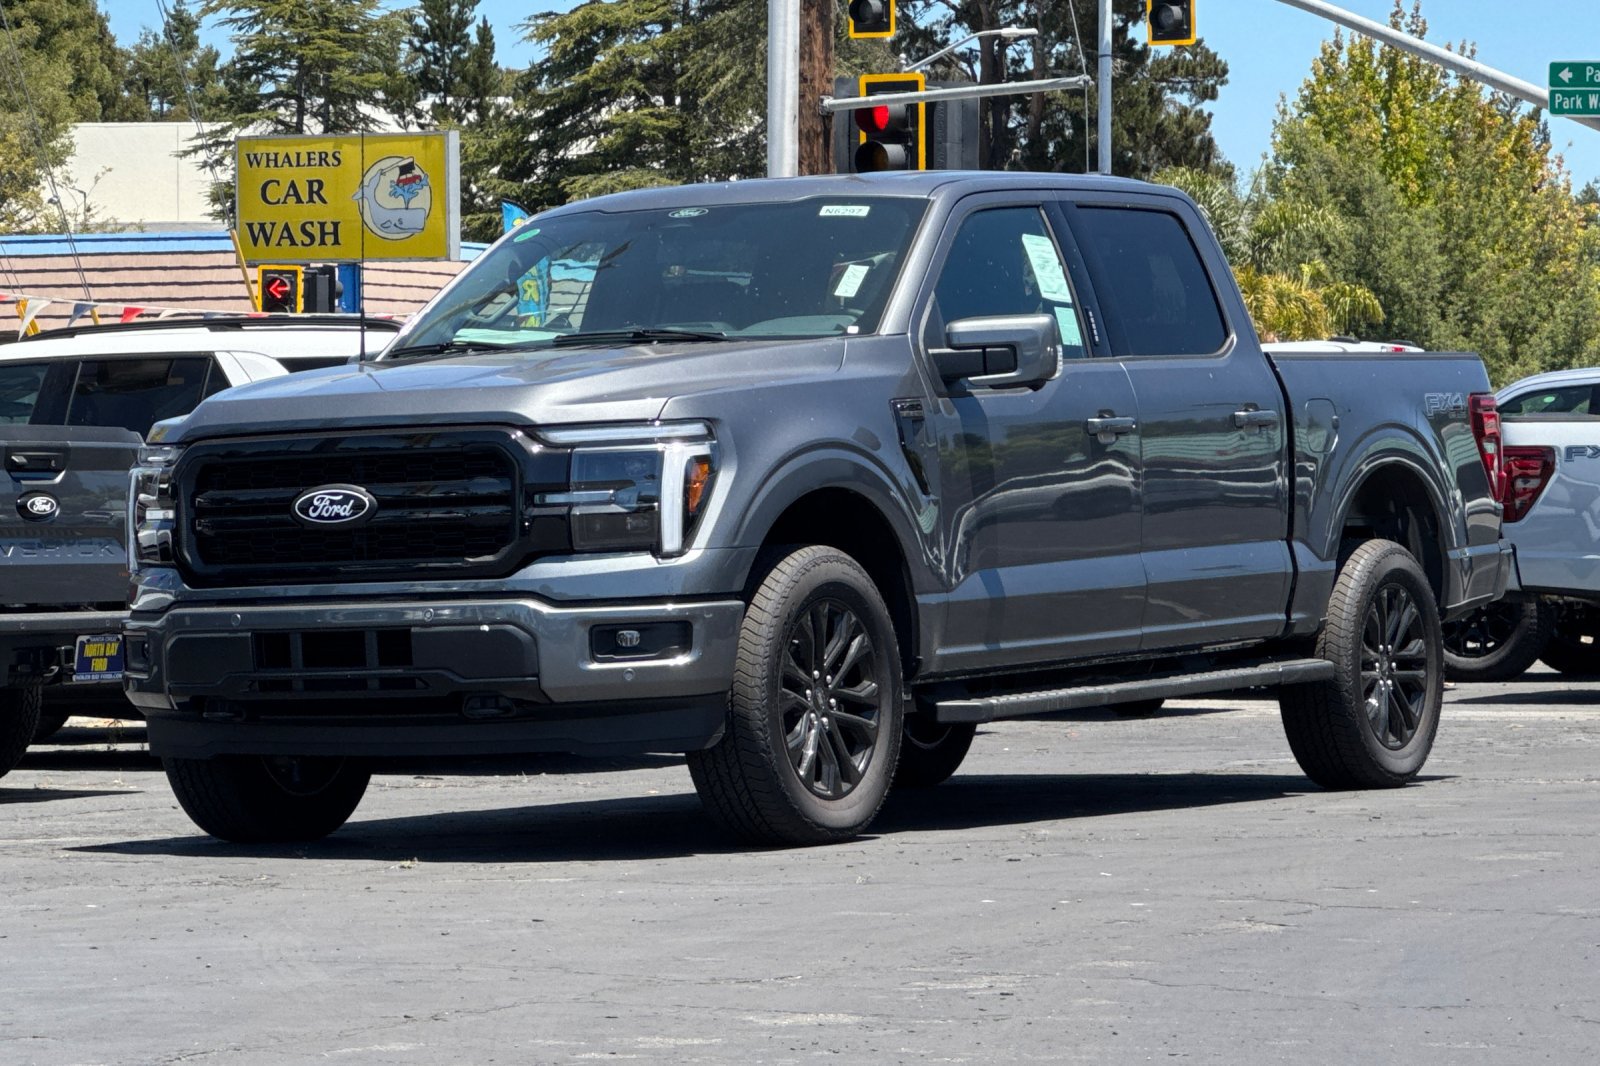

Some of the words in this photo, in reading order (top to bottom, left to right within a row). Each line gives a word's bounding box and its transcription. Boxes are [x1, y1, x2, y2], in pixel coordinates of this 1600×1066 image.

[1555, 93, 1583, 109] Park
[1588, 93, 1600, 109] W
[245, 150, 342, 169] WHALERS
[260, 178, 328, 205] CAR
[245, 220, 342, 248] WASH
[1424, 392, 1466, 418] FX4
[32, 499, 52, 512] Ford
[308, 494, 354, 518] Ford
[84, 643, 105, 657] NORTH
[105, 642, 119, 656] BAY
[91, 657, 108, 672] FORD
